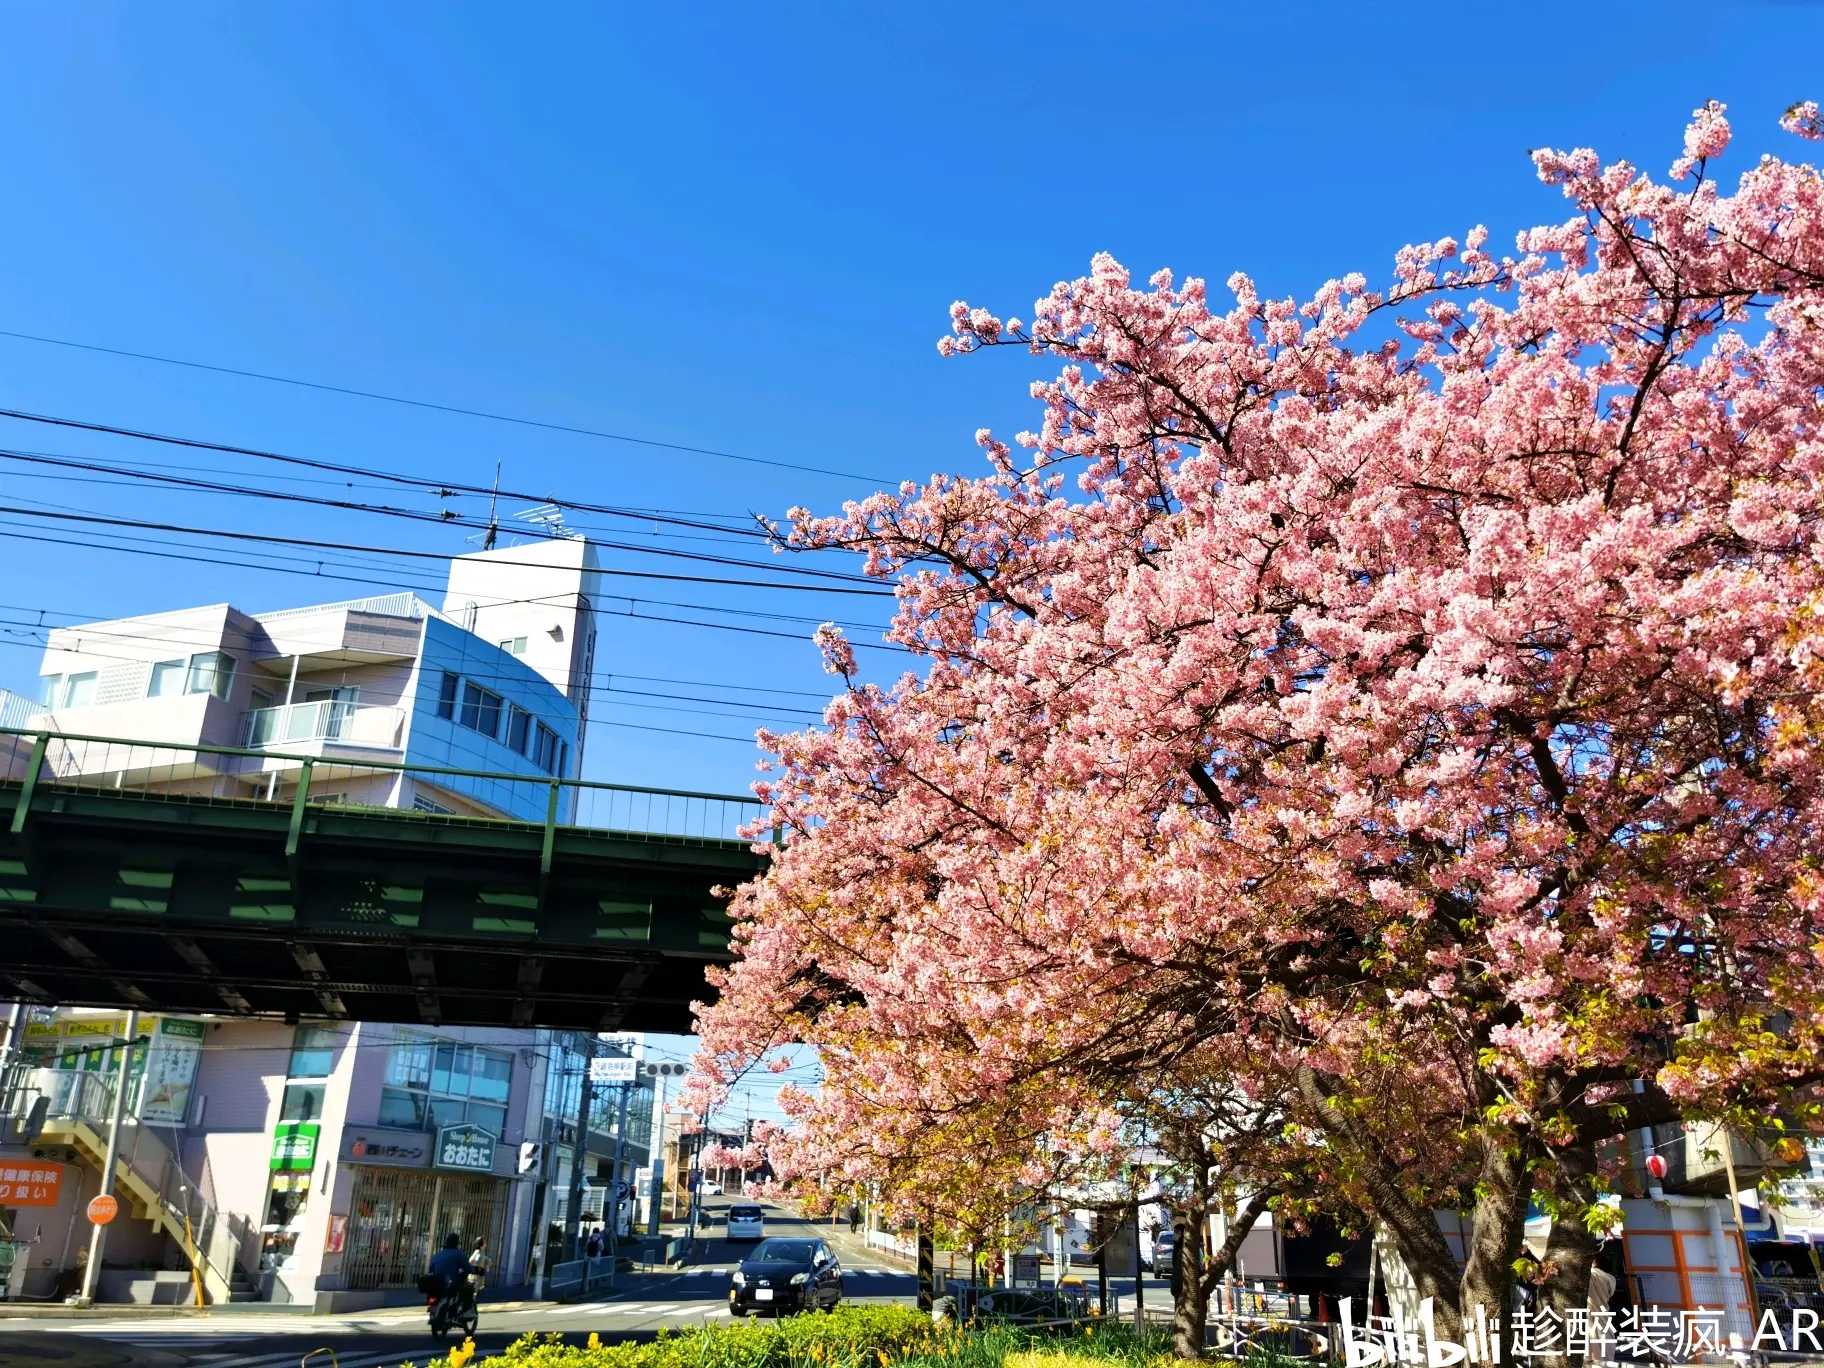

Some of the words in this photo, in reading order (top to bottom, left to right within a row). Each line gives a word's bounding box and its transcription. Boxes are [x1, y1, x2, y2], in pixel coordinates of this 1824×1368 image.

[449, 1130, 466, 1144] Sleep
[471, 1133, 490, 1145] House
[443, 1143, 491, 1166] おおたに
[0, 1168, 58, 1184] 健康保険
